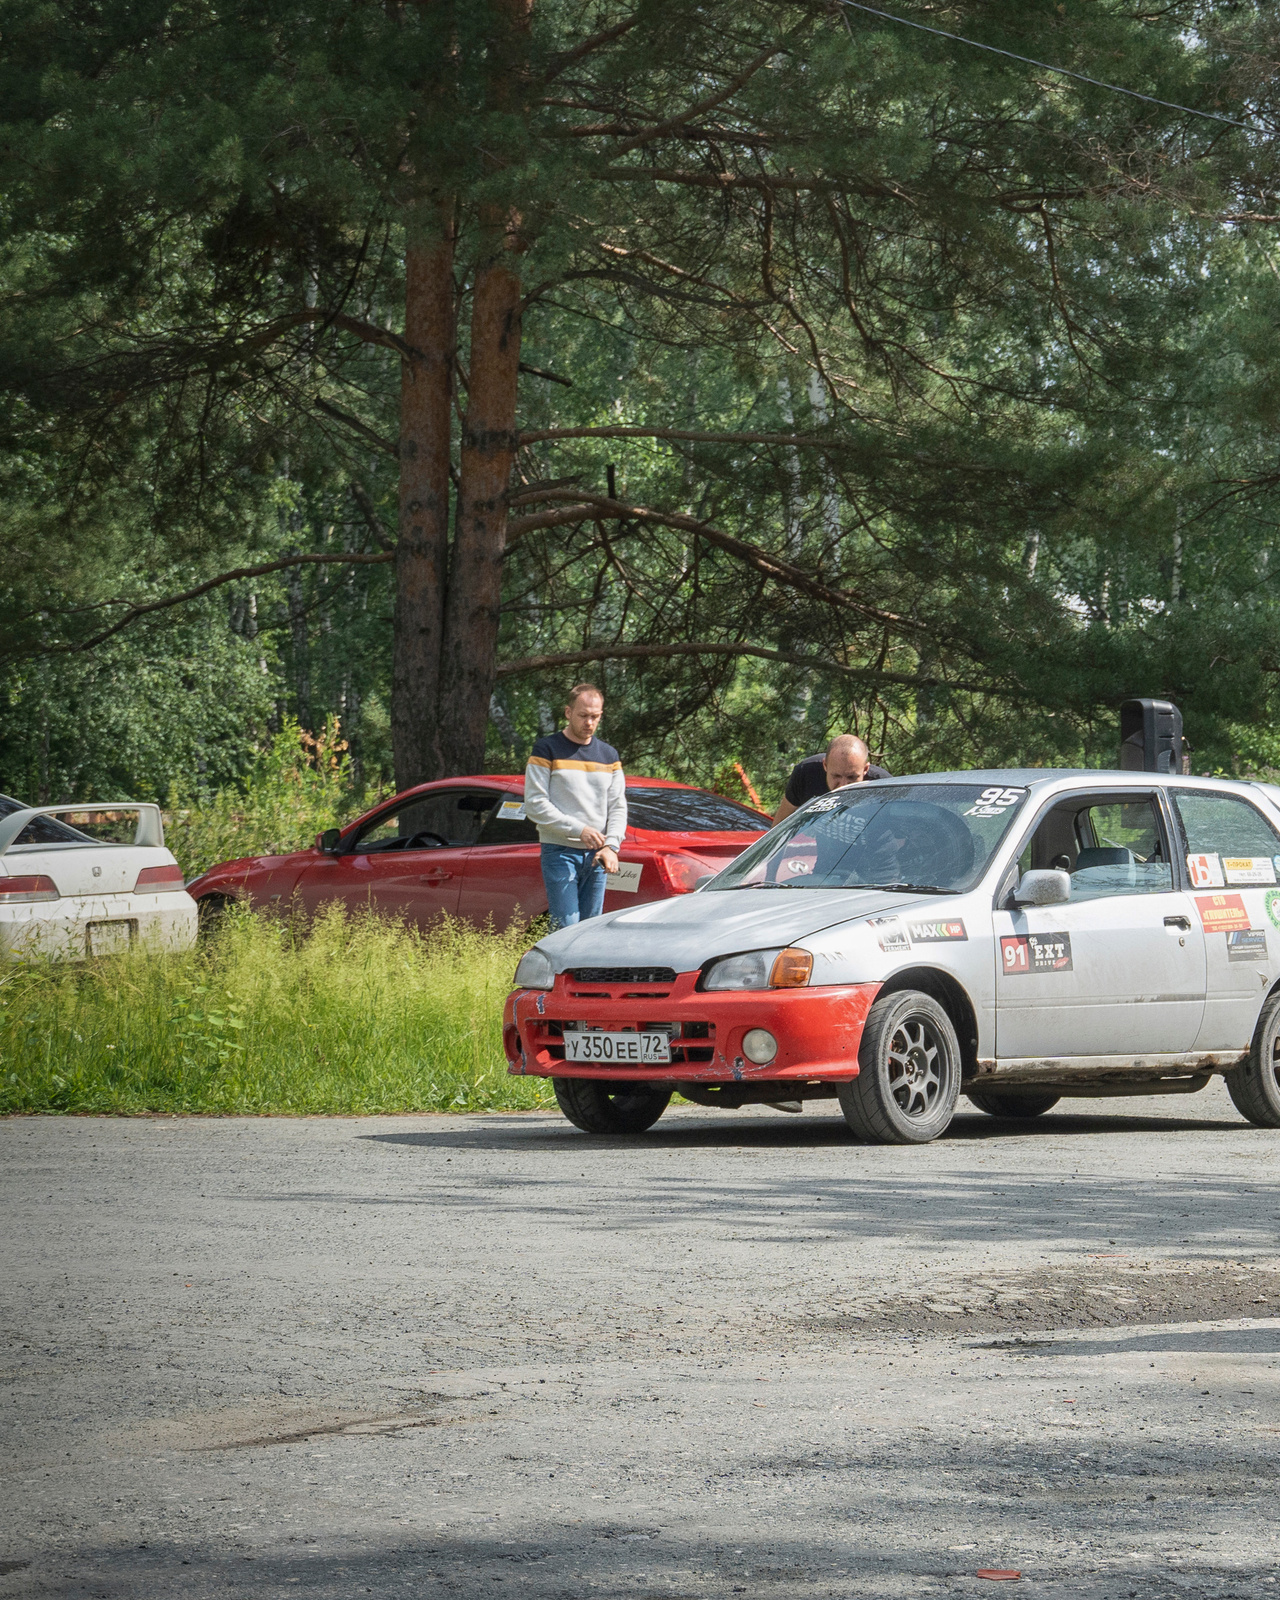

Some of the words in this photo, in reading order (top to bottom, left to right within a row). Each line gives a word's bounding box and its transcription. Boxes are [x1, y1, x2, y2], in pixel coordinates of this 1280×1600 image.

[975, 788, 1026, 805] 95
[910, 923, 940, 938] MAX
[949, 925, 960, 934] HP
[1004, 945, 1026, 967] 91
[1034, 943, 1065, 959] EXT
[642, 1035, 662, 1053] 72
